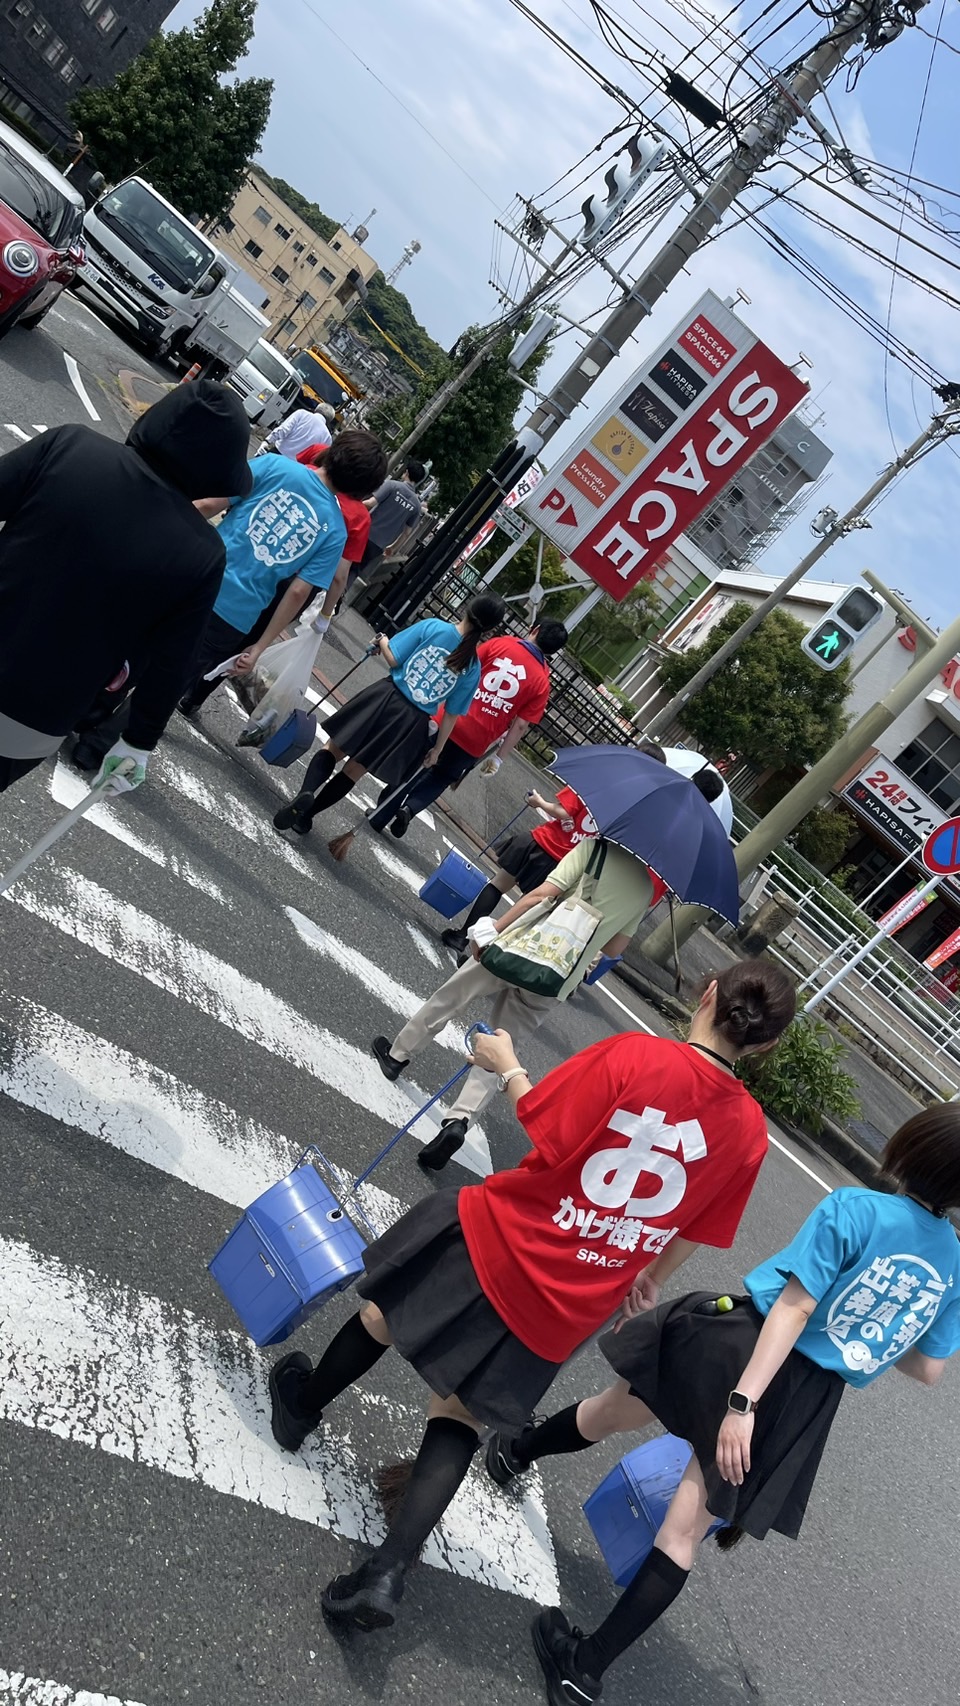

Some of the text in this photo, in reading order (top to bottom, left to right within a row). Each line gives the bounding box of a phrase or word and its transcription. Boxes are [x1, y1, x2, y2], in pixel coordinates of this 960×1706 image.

[101, 251, 143, 290] FUSO
[685, 331, 722, 369] SPACE666
[692, 322, 730, 360] SPACE444
[666, 372, 694, 400] FITNESS
[669, 367, 697, 396] HAPISA
[570, 463, 607, 501] Press&Town
[581, 462, 606, 488] Laundry
[593, 370, 779, 580] SPACE
[394, 496, 415, 512] STAFF
[538, 487, 566, 511] P
[266, 503, 305, 547] 笑顔の
[274, 516, 322, 562] 元気と
[482, 656, 527, 699] お
[481, 706, 500, 718] SPACE
[580, 1105, 708, 1218] お
[575, 1248, 627, 1269] SPACE
[860, 1269, 921, 1342] 笑顔の
[882, 1279, 947, 1361] 元気と
